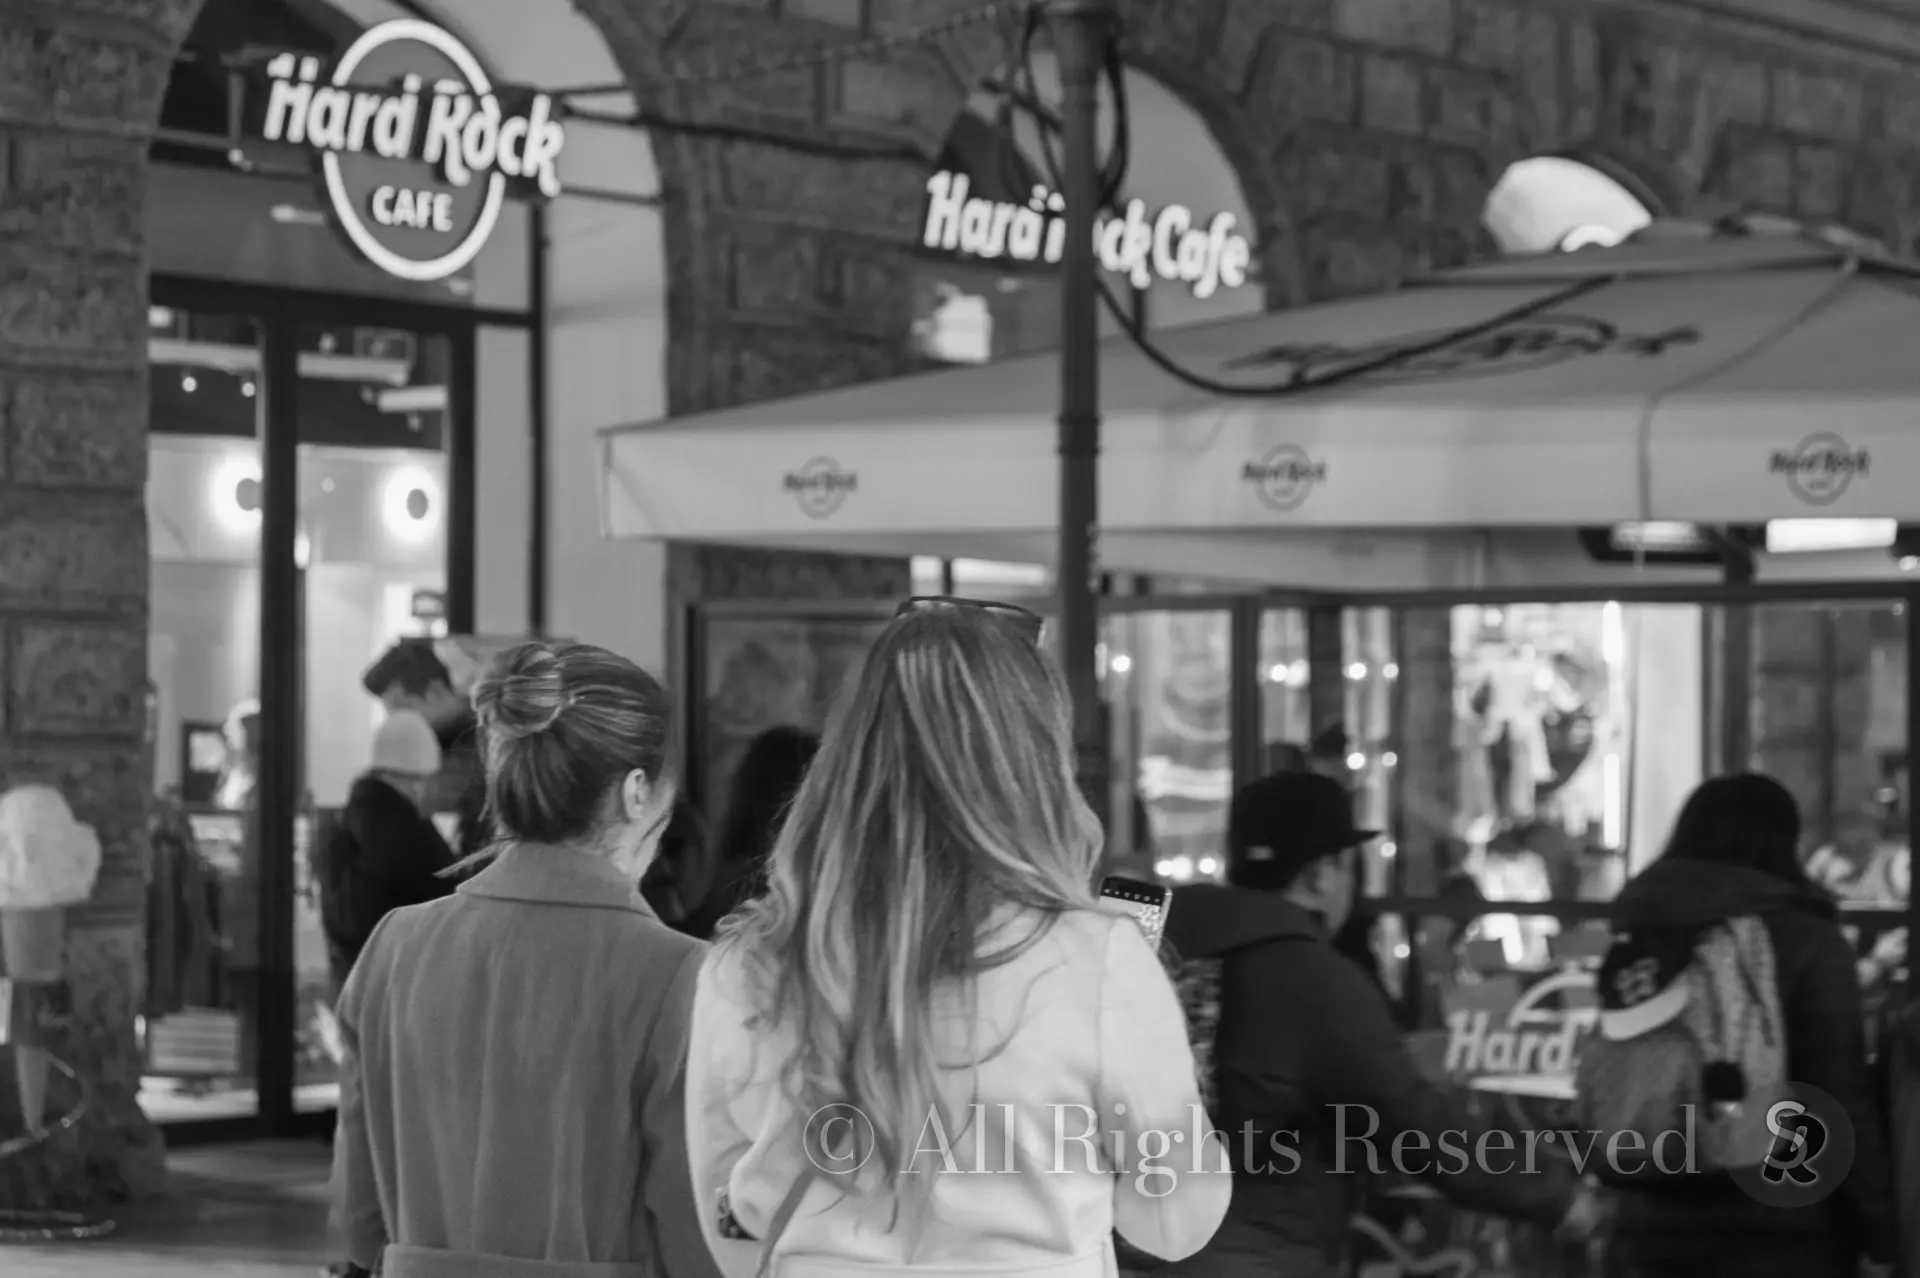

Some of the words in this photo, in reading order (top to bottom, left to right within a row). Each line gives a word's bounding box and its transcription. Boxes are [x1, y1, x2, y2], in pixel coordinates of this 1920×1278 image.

[264, 53, 422, 158] Hard
[424, 79, 564, 197] Rock
[372, 185, 453, 232] CAFE
[1153, 204, 1250, 298] Cafe
[1444, 1008, 1580, 1074] Hard
